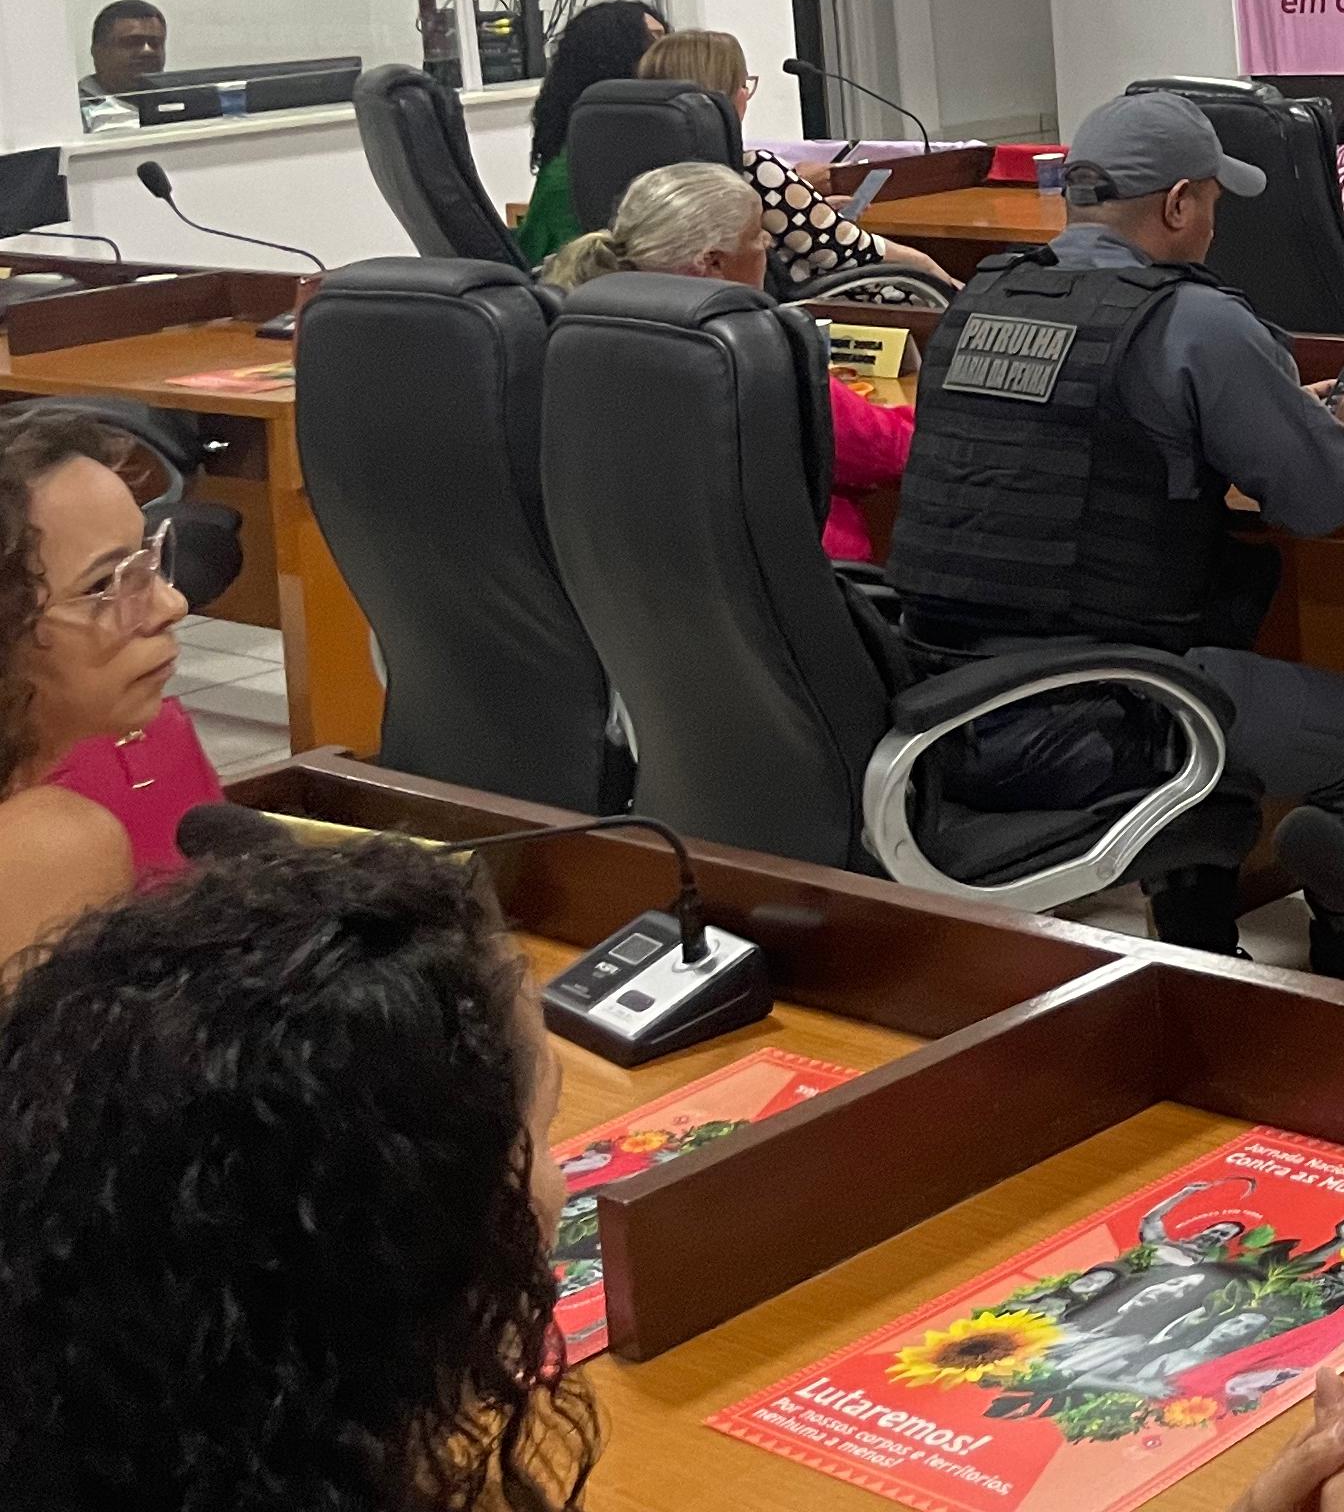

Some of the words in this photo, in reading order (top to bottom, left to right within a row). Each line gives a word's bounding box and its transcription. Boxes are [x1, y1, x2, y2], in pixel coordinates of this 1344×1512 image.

[960, 318, 1068, 361] PATRULHA
[1003, 360, 1055, 396] PENHA
[1224, 1151, 1291, 1177] Contra
[1289, 1170, 1320, 1186] as
[1244, 1142, 1305, 1165] Jornada
[770, 1396, 804, 1414] Por
[800, 1407, 858, 1437] nossos
[854, 1429, 914, 1459] corpos
[909, 1449, 926, 1461] e
[794, 1376, 993, 1456] Lutaremos!
[752, 1407, 827, 1444] nenhuma
[822, 1435, 838, 1447] a
[838, 1439, 907, 1470] menos!
